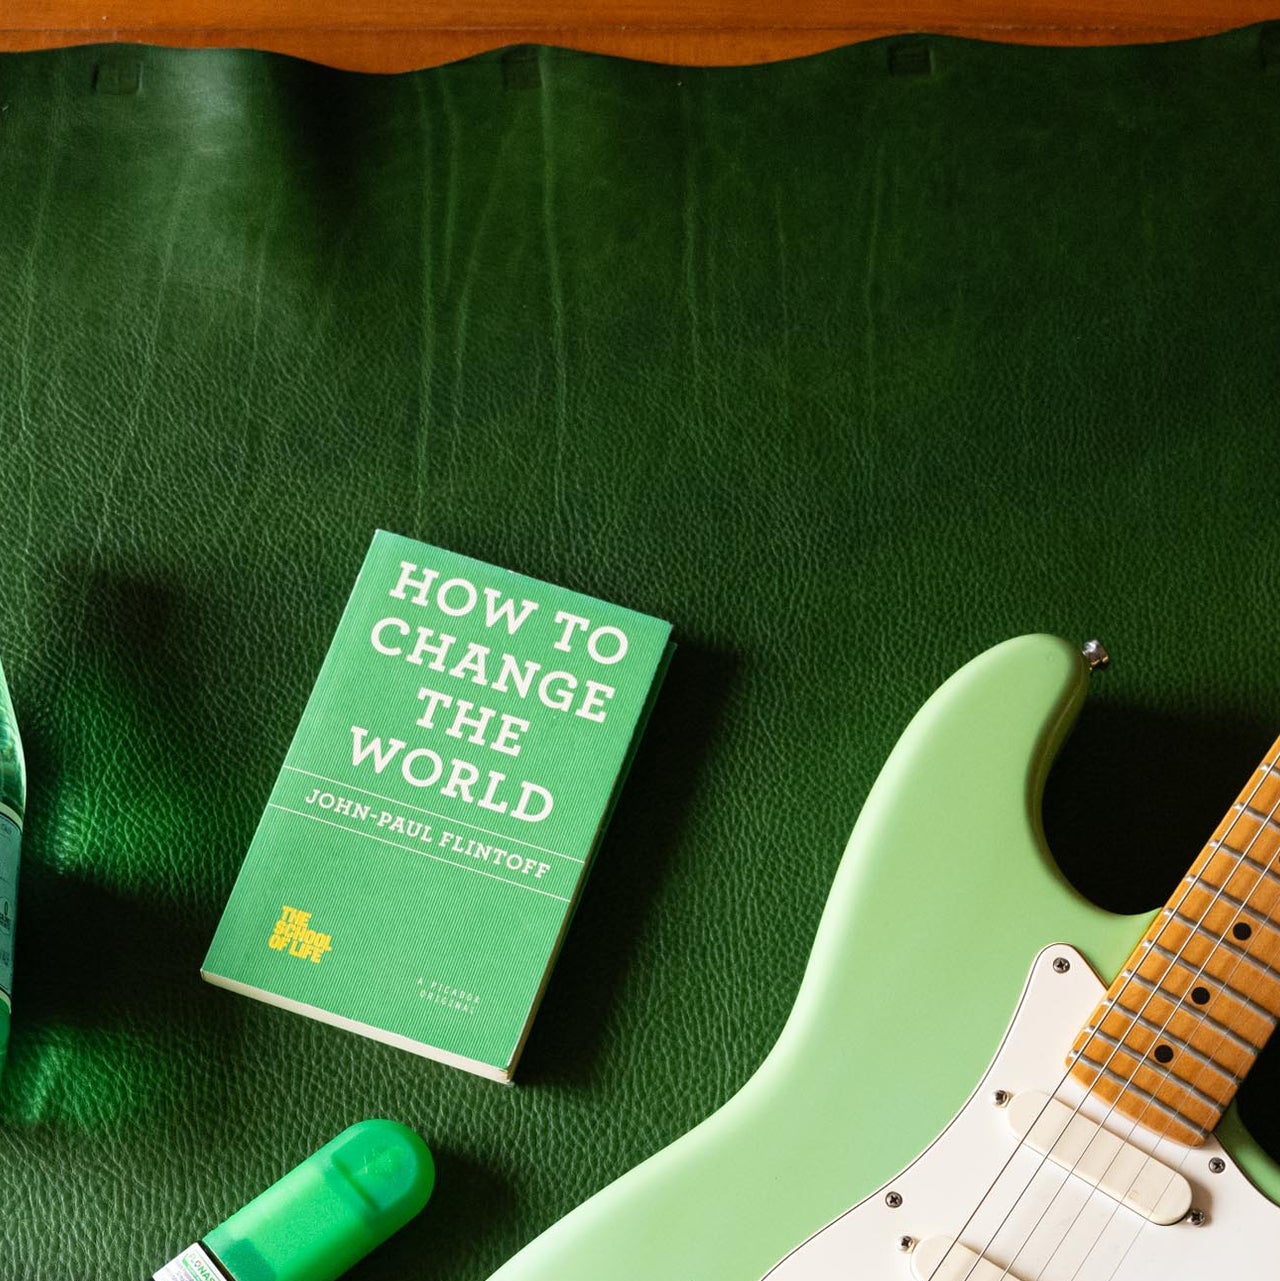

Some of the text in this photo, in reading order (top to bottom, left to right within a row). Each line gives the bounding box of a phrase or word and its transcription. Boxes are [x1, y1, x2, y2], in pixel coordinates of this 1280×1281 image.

[389, 560, 629, 665] HOW TO
[370, 617, 615, 723] CHANGE
[416, 687, 530, 757] THE
[350, 725, 554, 822] WORLD
[305, 789, 551, 879] JOHN-PAUL FLINTOFF
[268, 934, 325, 964] OF LIFE
[274, 919, 333, 952] SCHOOL
[282, 904, 312, 927] THE
[417, 977, 424, 986] A
